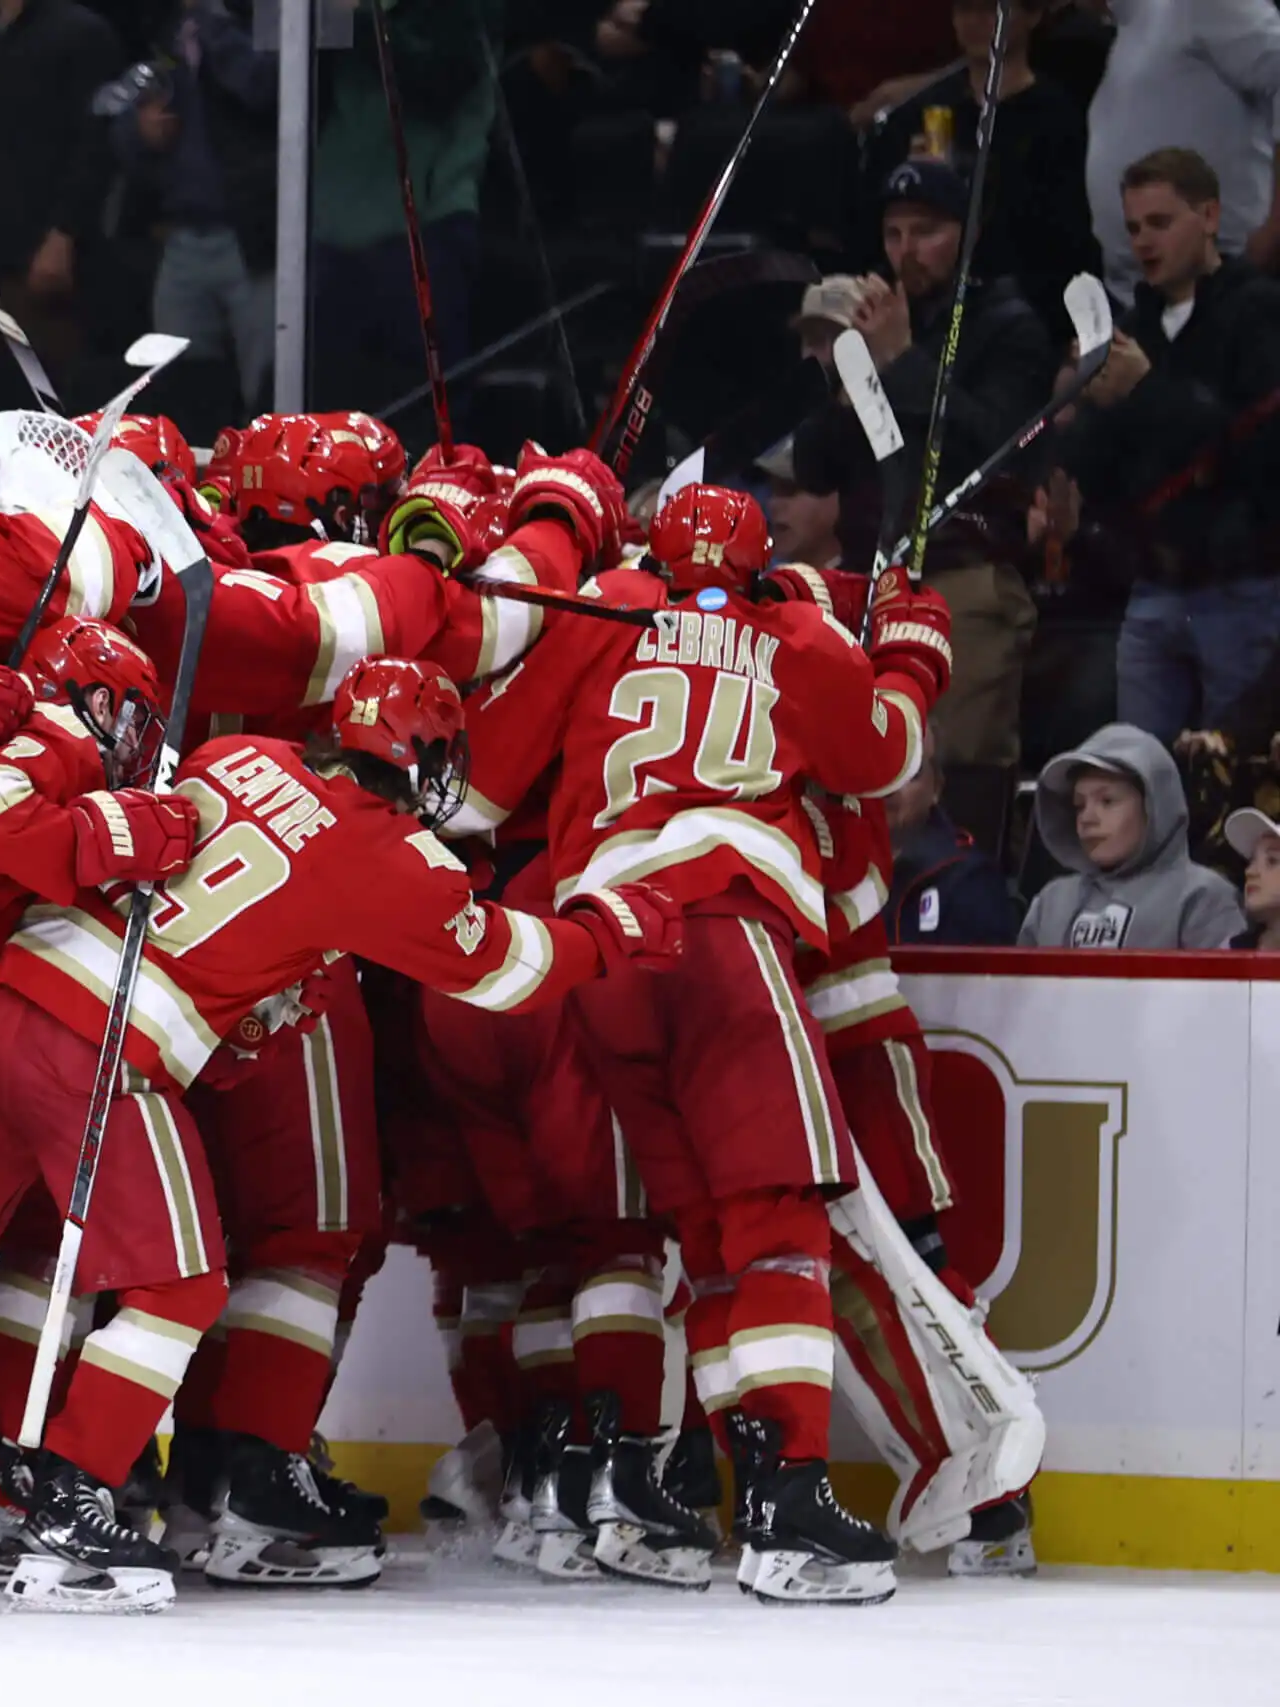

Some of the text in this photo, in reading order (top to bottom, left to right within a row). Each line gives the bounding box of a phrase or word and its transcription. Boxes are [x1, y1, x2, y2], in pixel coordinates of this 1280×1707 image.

[691, 542, 724, 568] 24
[636, 608, 780, 686] CEBRIAN
[205, 745, 338, 855] LEMYRE
[592, 667, 784, 830] 24
[911, 1286, 1001, 1414] TRUE
